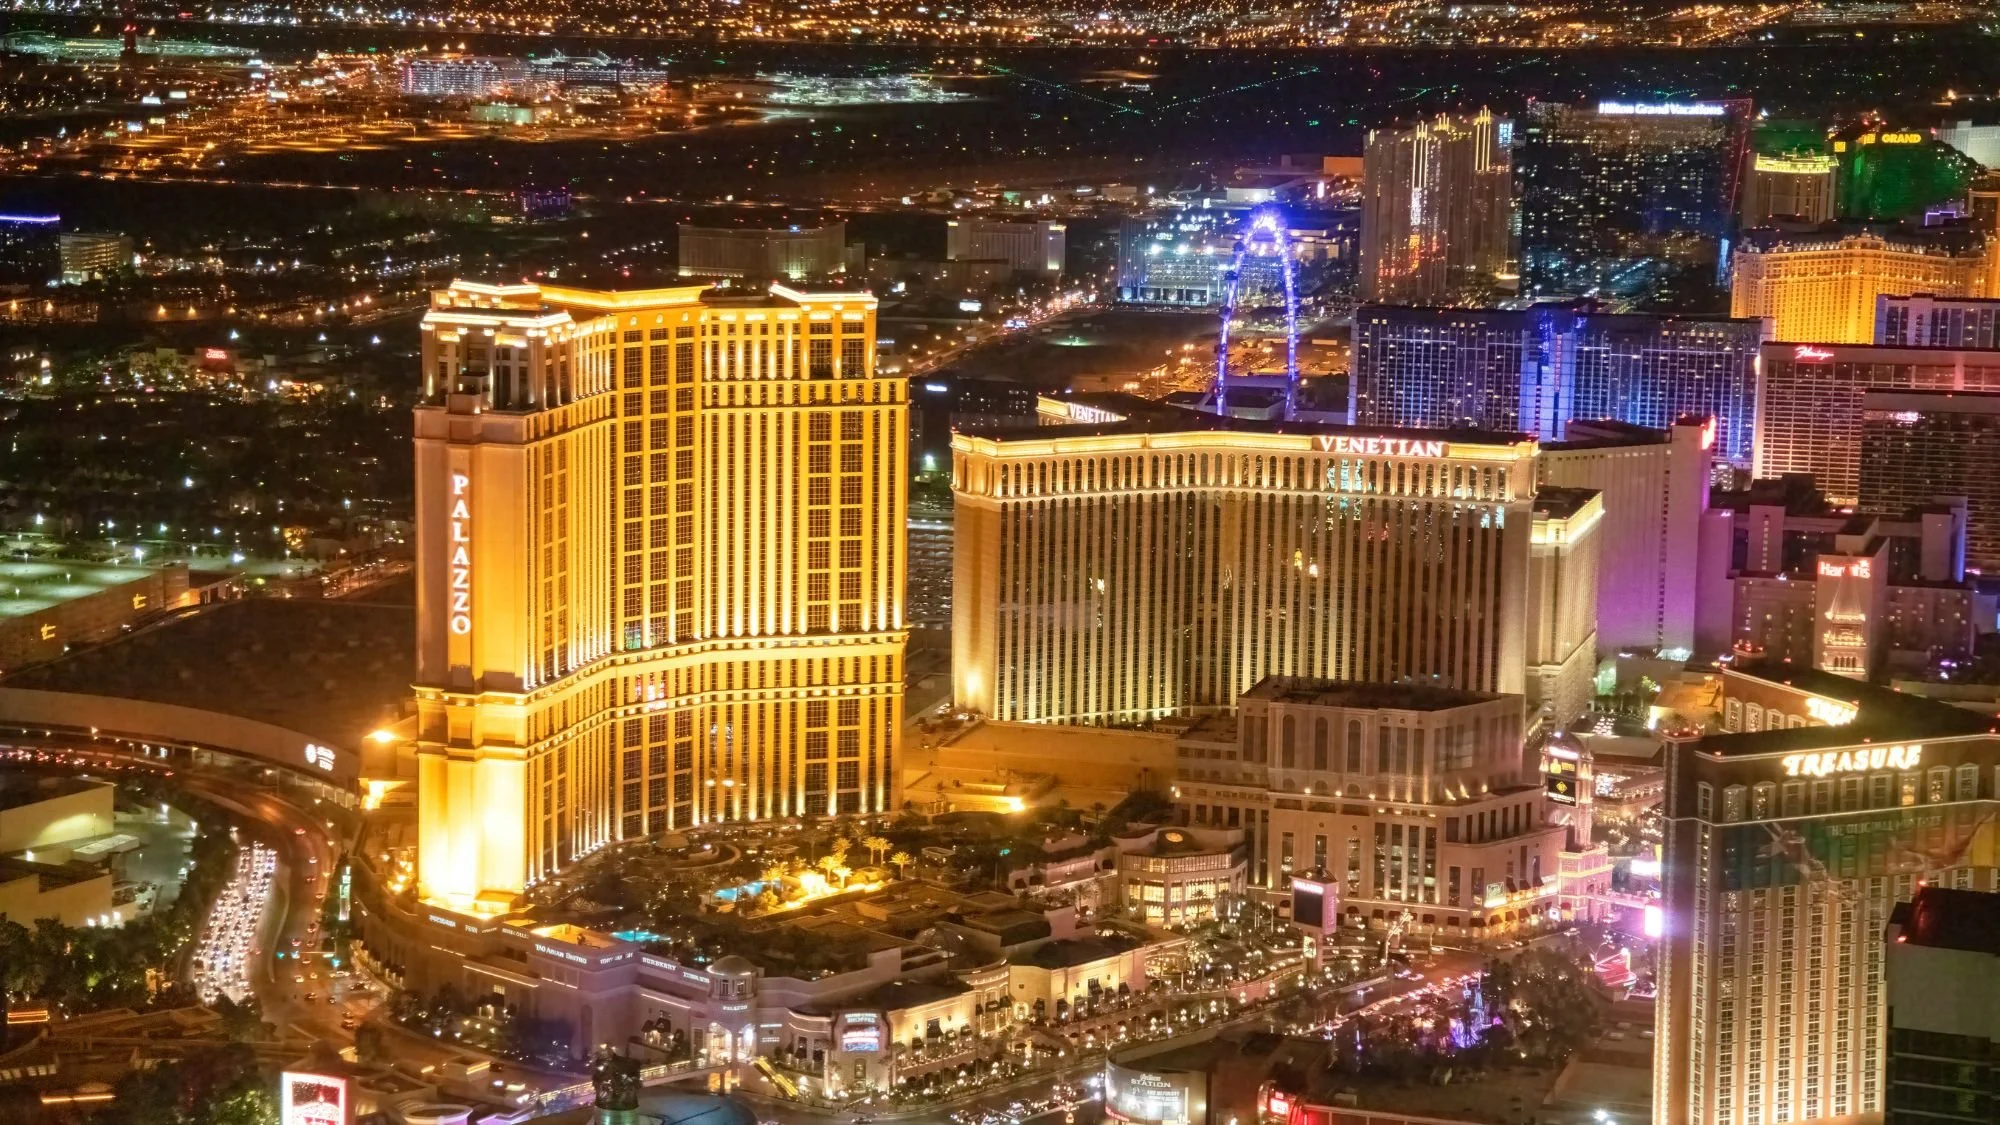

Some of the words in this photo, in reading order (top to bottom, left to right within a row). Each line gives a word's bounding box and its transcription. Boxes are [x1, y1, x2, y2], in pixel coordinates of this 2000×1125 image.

[1598, 102, 1634, 114] Hilton
[1635, 103, 1669, 115] Grand
[1669, 102, 1725, 115] Vacations
[1881, 133, 1921, 143] GRAND
[1319, 435, 1443, 457] VENETIAN
[451, 475, 471, 634] PALAZZO
[1782, 745, 1922, 777] TREASURE
[642, 957, 677, 971] BURBERRY
[1130, 1078, 1172, 1088] STATION
